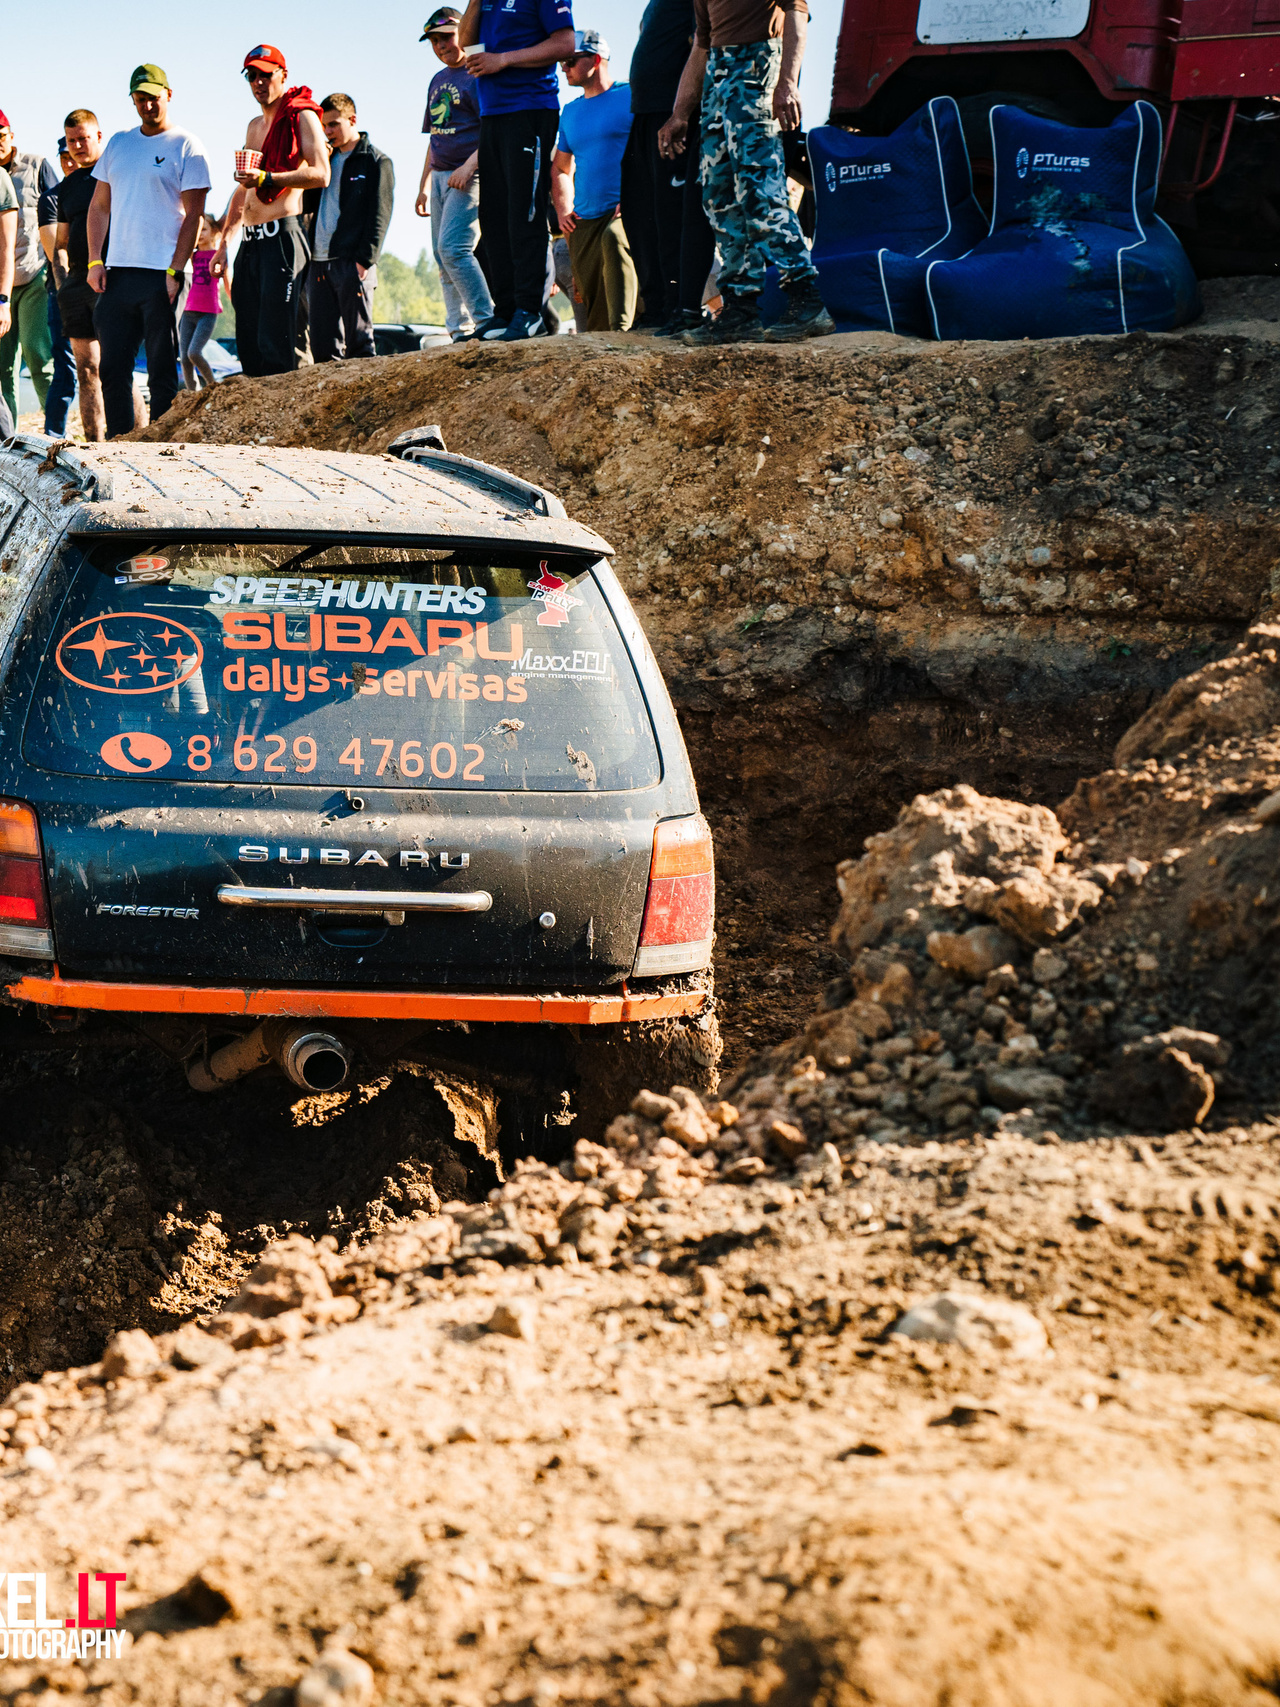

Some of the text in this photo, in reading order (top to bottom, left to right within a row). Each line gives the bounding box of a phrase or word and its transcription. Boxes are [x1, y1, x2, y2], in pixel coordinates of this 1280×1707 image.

[1033, 153, 1091, 168] PTuras
[839, 162, 892, 179] PTuras
[115, 569, 174, 585] BLOX
[209, 576, 487, 615] SPEEDHUNTERS
[533, 589, 574, 611] RALLY
[223, 612, 523, 661] SUBARU
[511, 671, 612, 682] engine management
[187, 735, 485, 782] 8 629 47602
[238, 845, 470, 869] SUBARU
[96, 904, 200, 920] FORESTER
